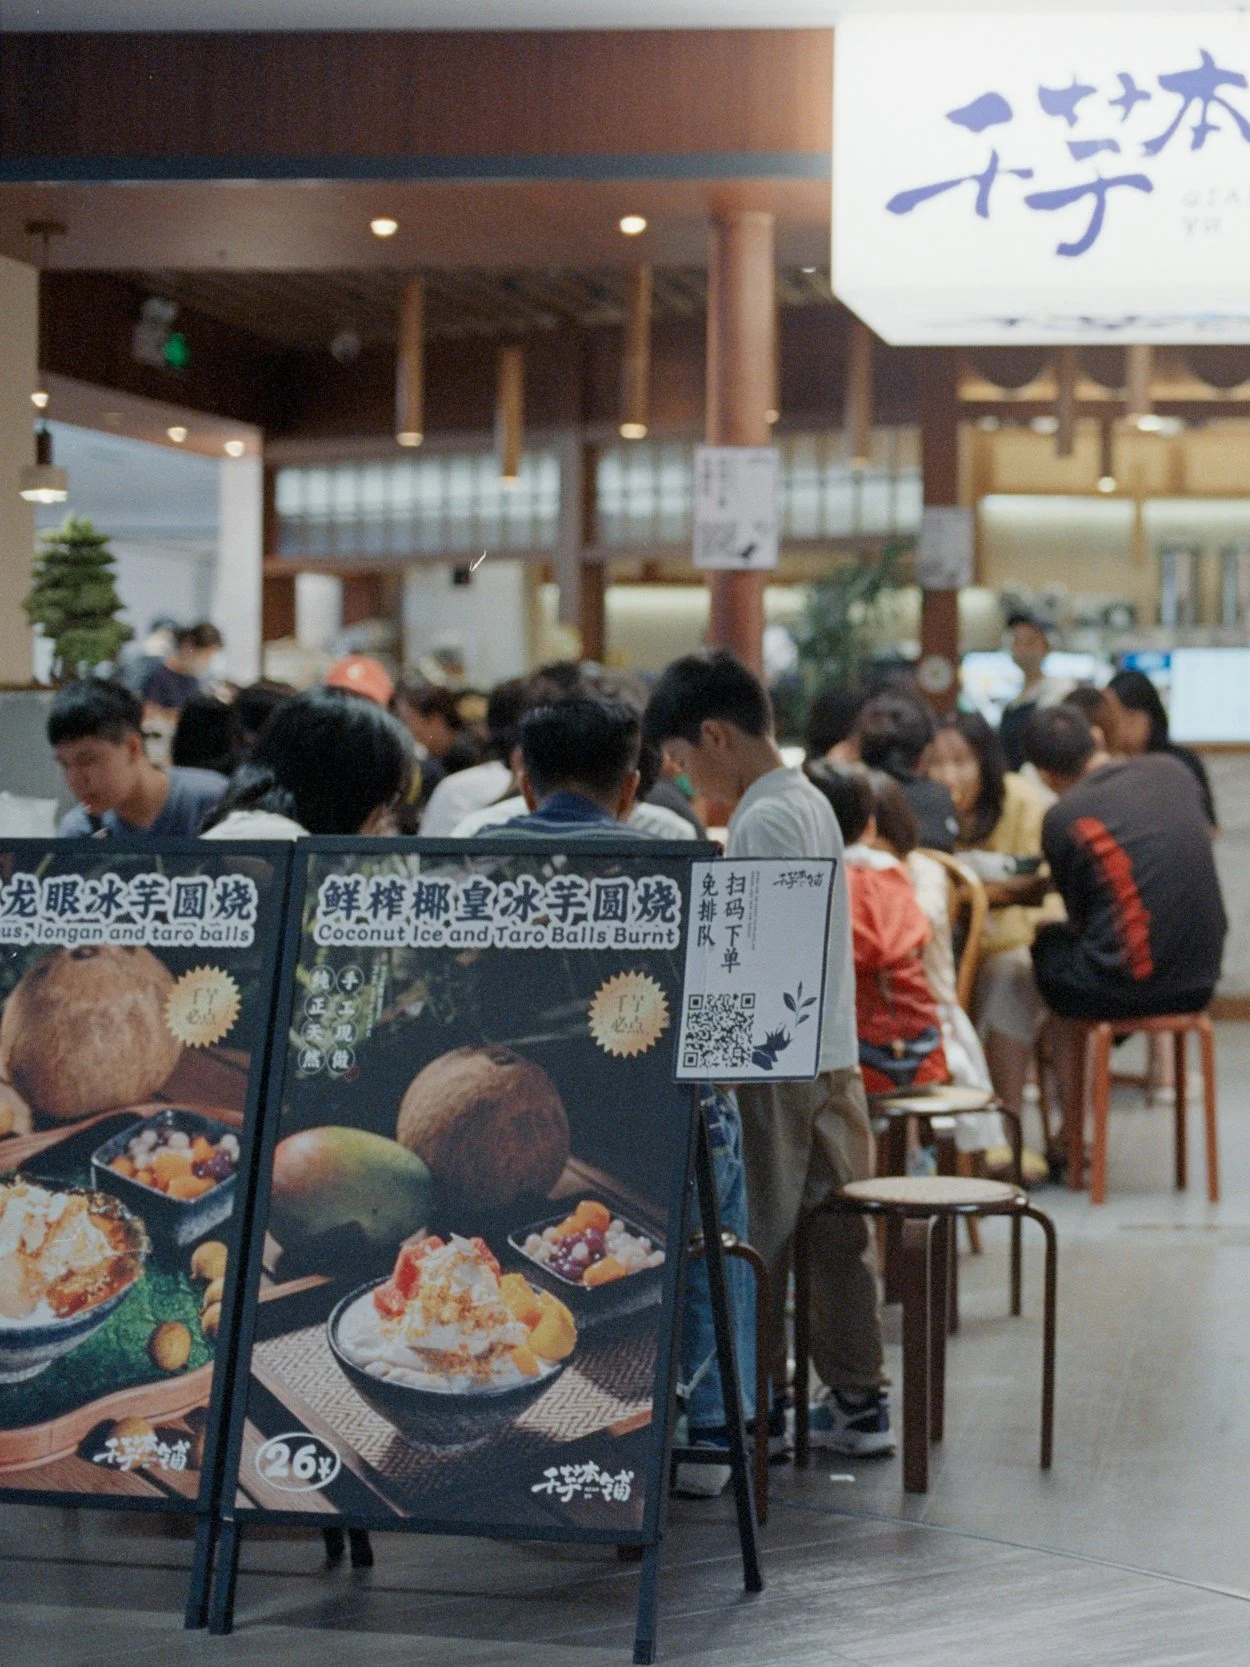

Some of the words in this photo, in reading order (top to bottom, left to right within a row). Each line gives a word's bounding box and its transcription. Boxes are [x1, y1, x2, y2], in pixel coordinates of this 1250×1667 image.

[0, 879, 252, 921] 龙眼冰芋圆烧
[322, 879, 677, 924] 鲜榨椰皇冰芋圆烧
[697, 872, 719, 947] 免排队
[37, 924, 103, 942] longan
[110, 926, 145, 941] and
[152, 927, 194, 942] taro
[201, 926, 249, 942] balls
[318, 924, 405, 941] Coconut
[413, 925, 443, 942] Ice
[450, 925, 488, 942] and
[496, 926, 545, 943] Taro
[551, 926, 607, 944] Balls
[613, 927, 676, 944] Burnt
[721, 871, 746, 974] 扫码下单
[531, 1461, 634, 1502] 千芋本铺
